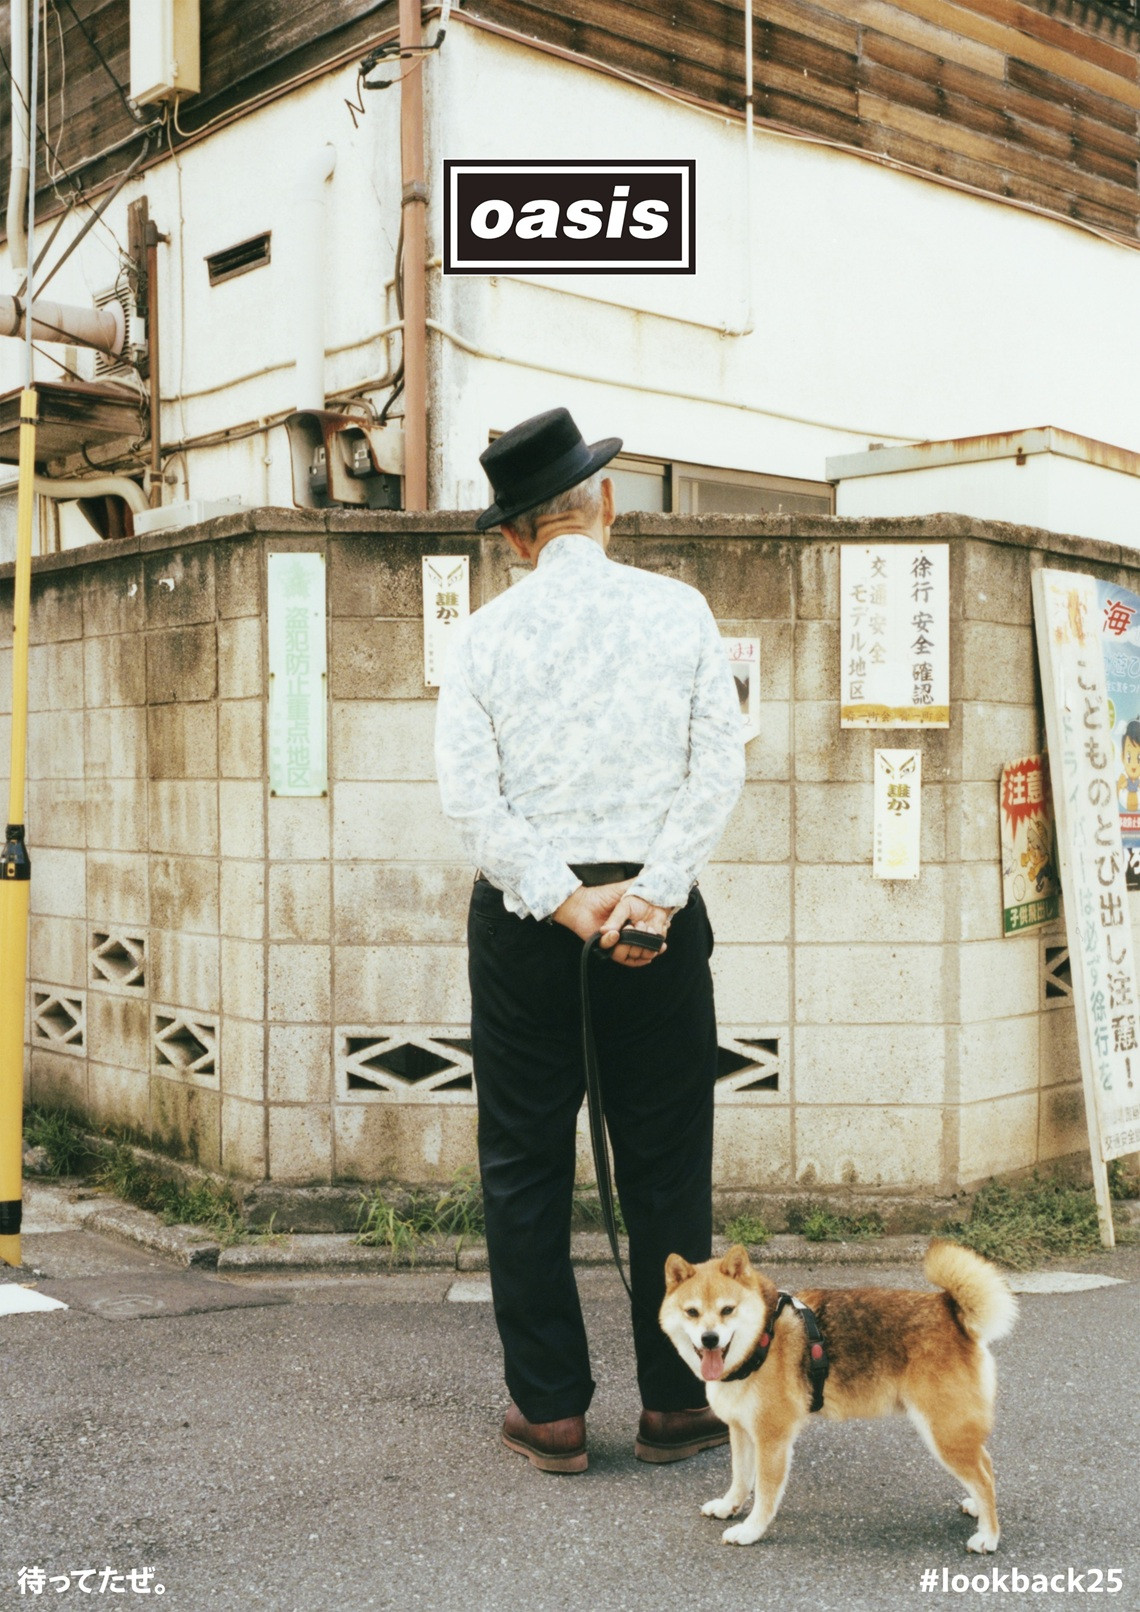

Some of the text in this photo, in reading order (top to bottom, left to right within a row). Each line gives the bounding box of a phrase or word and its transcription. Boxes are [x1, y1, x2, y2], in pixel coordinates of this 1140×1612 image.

[848, 584, 869, 700] モデル地区
[869, 555, 888, 665] 交通安全
[285, 606, 311, 788] 盗犯防止重点地区
[1008, 770, 1043, 806] 注意
